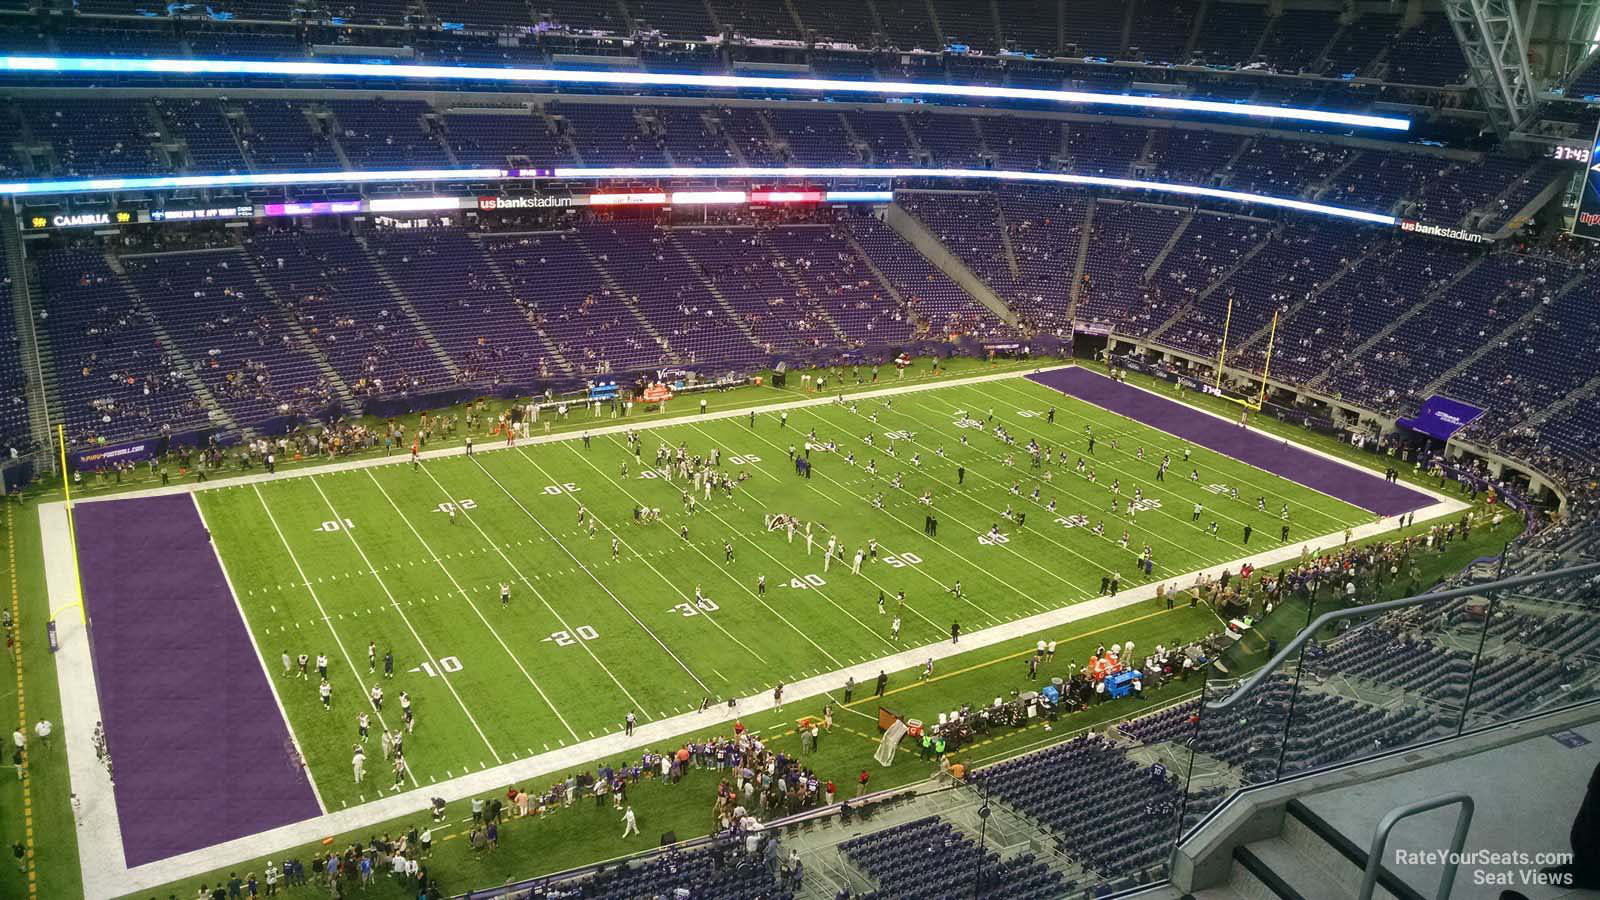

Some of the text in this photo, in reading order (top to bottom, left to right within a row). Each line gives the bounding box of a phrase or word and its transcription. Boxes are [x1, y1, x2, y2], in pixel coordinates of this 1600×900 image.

[1554, 146, 1590, 163] 37:43
[53, 213, 110, 226] CAMBRIA
[728, 454, 761, 465] 50
[544, 482, 581, 495] 30
[883, 552, 923, 567] 50
[790, 574, 826, 590] 40
[675, 599, 720, 617] 30
[551, 625, 599, 647] 20
[419, 655, 464, 678] 10
